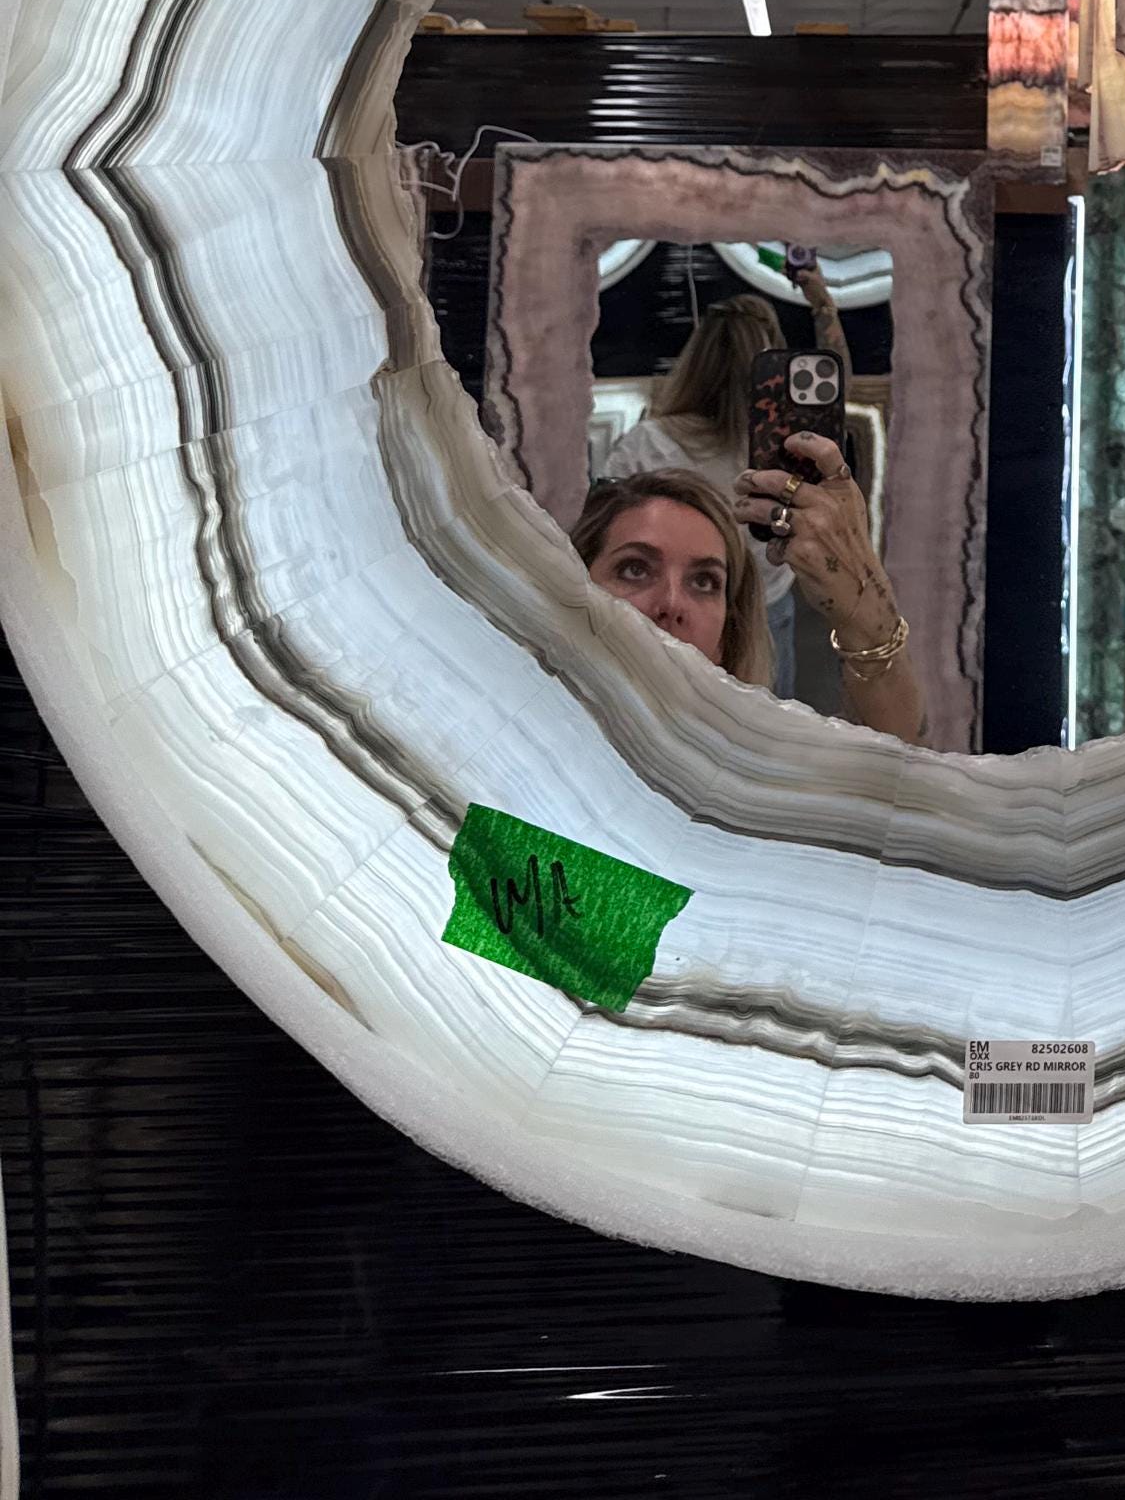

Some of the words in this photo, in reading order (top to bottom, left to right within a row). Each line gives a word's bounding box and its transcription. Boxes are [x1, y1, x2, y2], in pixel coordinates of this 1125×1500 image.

[969, 1040, 989, 1053] EM
[1031, 1044, 1088, 1054] 82502608
[969, 1051, 989, 1061] OXX
[968, 1061, 993, 1072] CRIS
[995, 1061, 1022, 1072] GREY
[1025, 1061, 1041, 1072] RD
[1043, 1061, 1087, 1072] MIRROR
